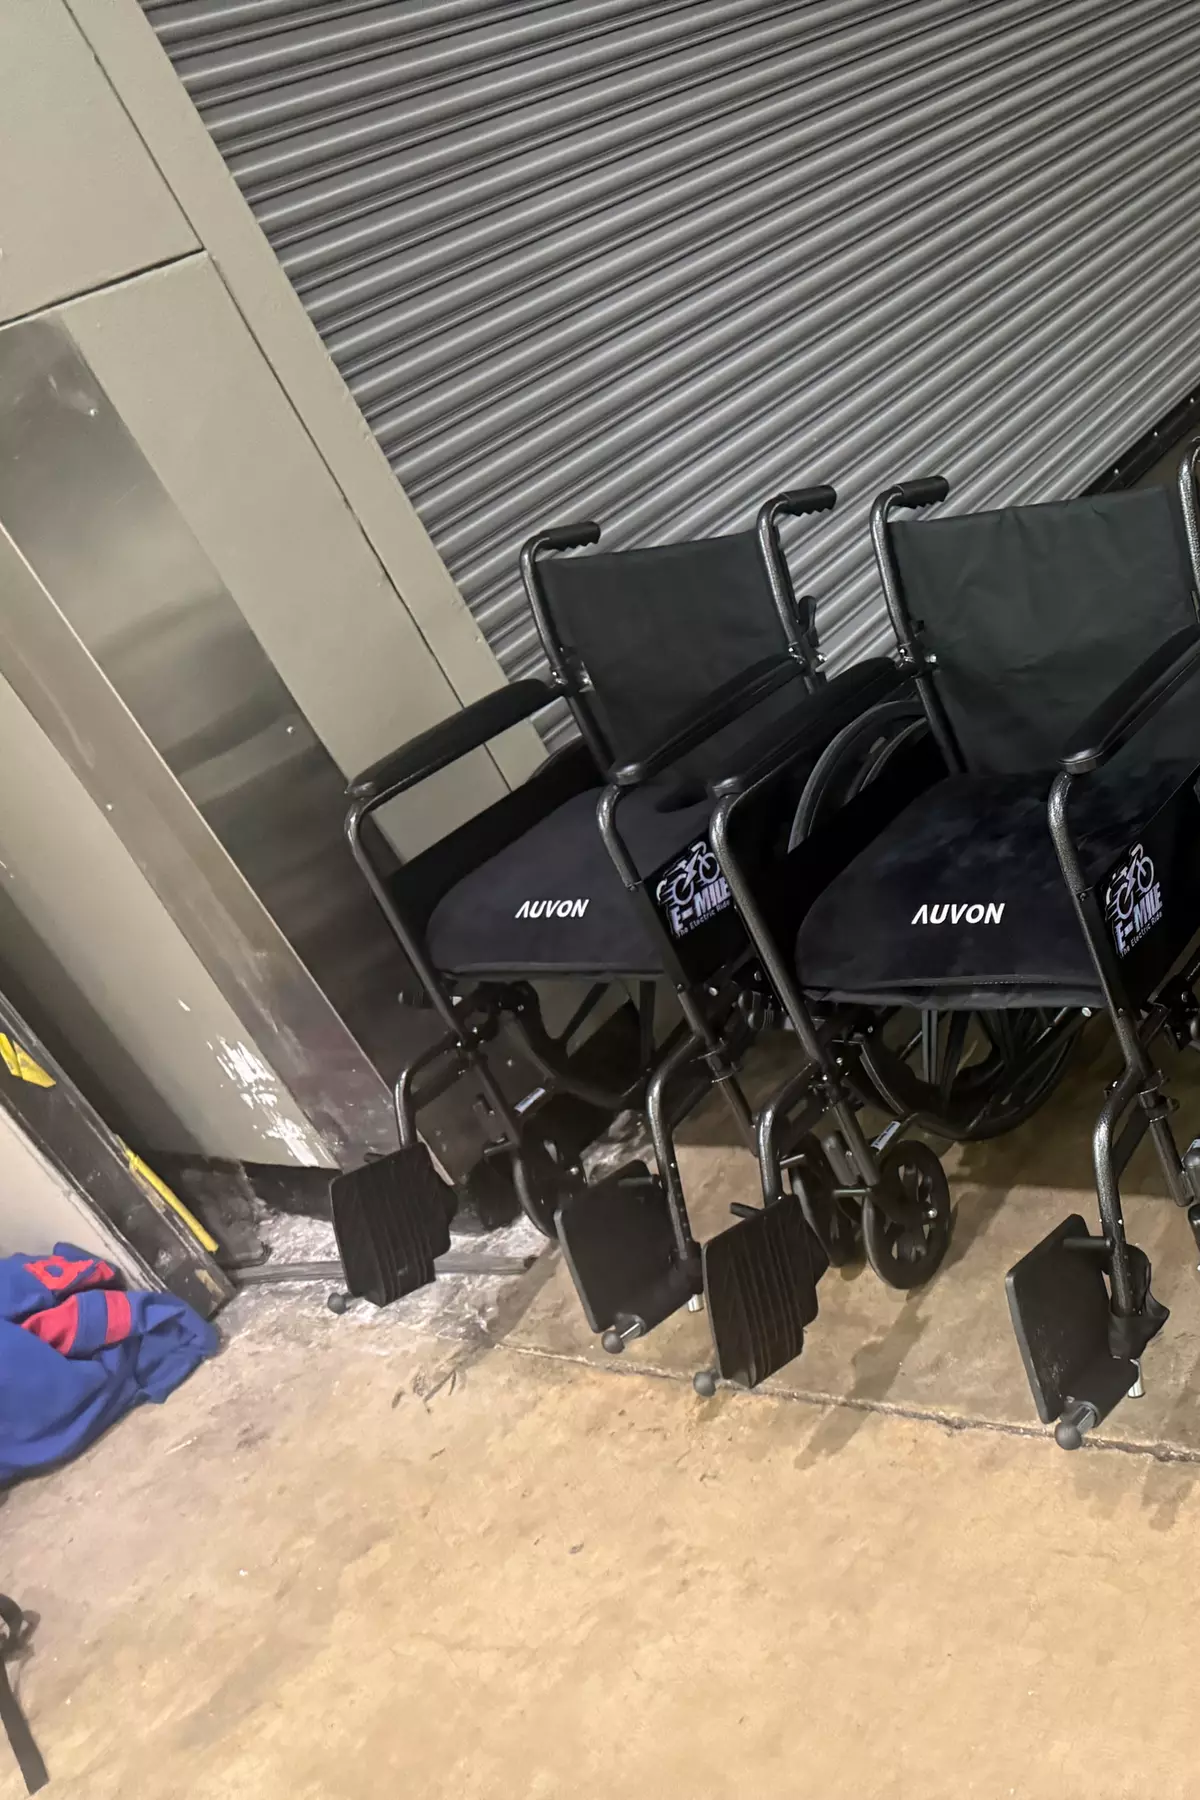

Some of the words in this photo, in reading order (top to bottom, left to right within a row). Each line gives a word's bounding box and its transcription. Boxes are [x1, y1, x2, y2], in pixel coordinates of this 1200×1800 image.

[515, 899, 590, 919] AUVON
[671, 876, 732, 932] E-MILE
[911, 903, 1006, 925] AUVON
[1115, 882, 1163, 953] E-MILE
